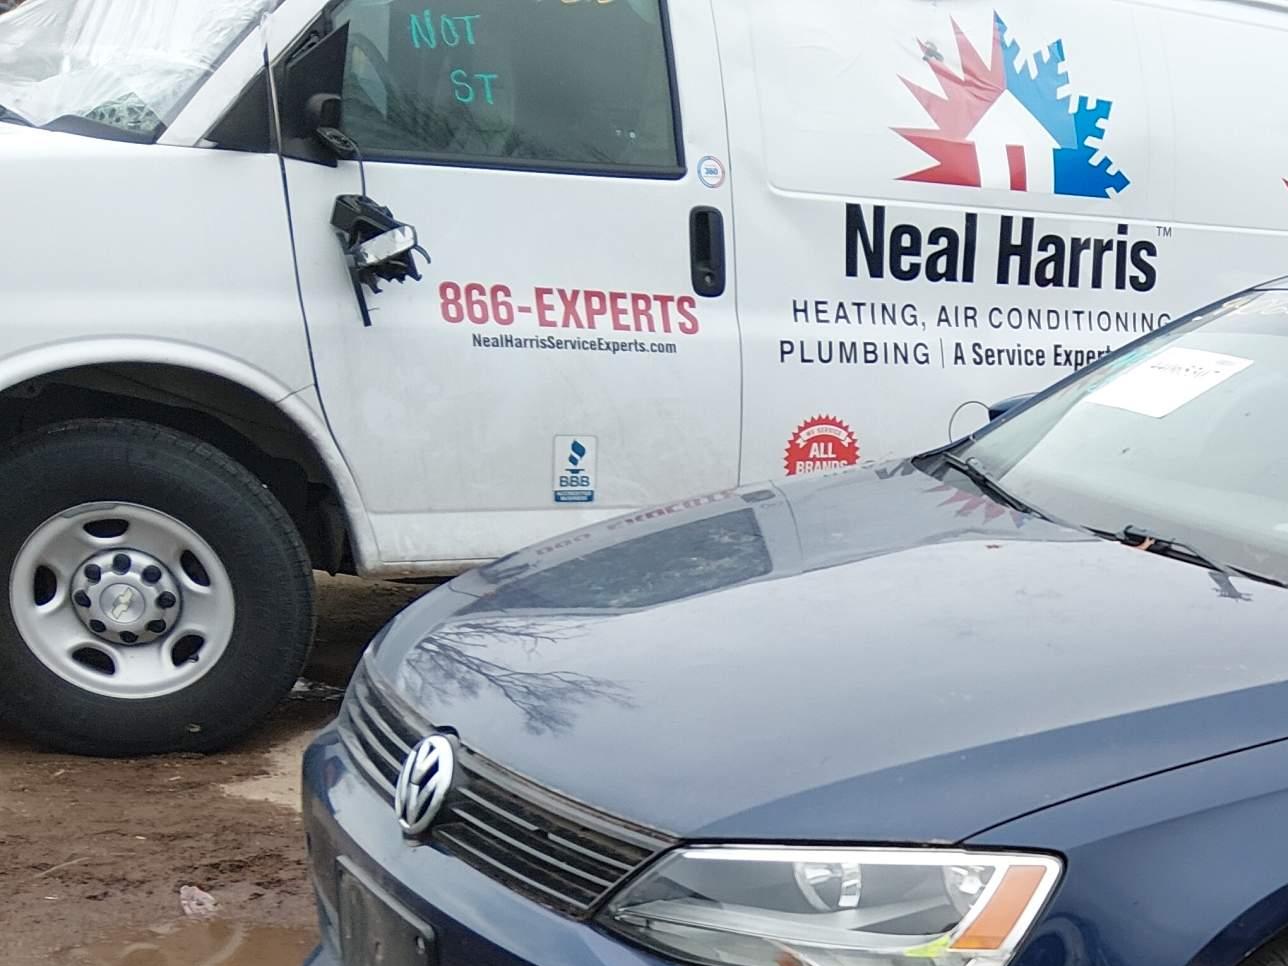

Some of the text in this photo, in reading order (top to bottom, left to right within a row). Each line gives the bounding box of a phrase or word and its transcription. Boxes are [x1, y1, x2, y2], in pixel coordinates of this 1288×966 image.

[408, 9, 480, 48] NOT
[450, 69, 498, 104] ST
[845, 203, 1157, 292] Neal Harris
[438, 281, 699, 335] 866-EXPERTS
[792, 299, 1171, 333] HEATING, AIR CONDITIONING
[472, 333, 677, 355] NealHarrisServiceExperts.com
[779, 340, 931, 365] PLUMBING
[953, 342, 966, 365] A
[972, 342, 1045, 366] Service
[808, 442, 837, 458] ALL
[559, 475, 590, 487] BBB
